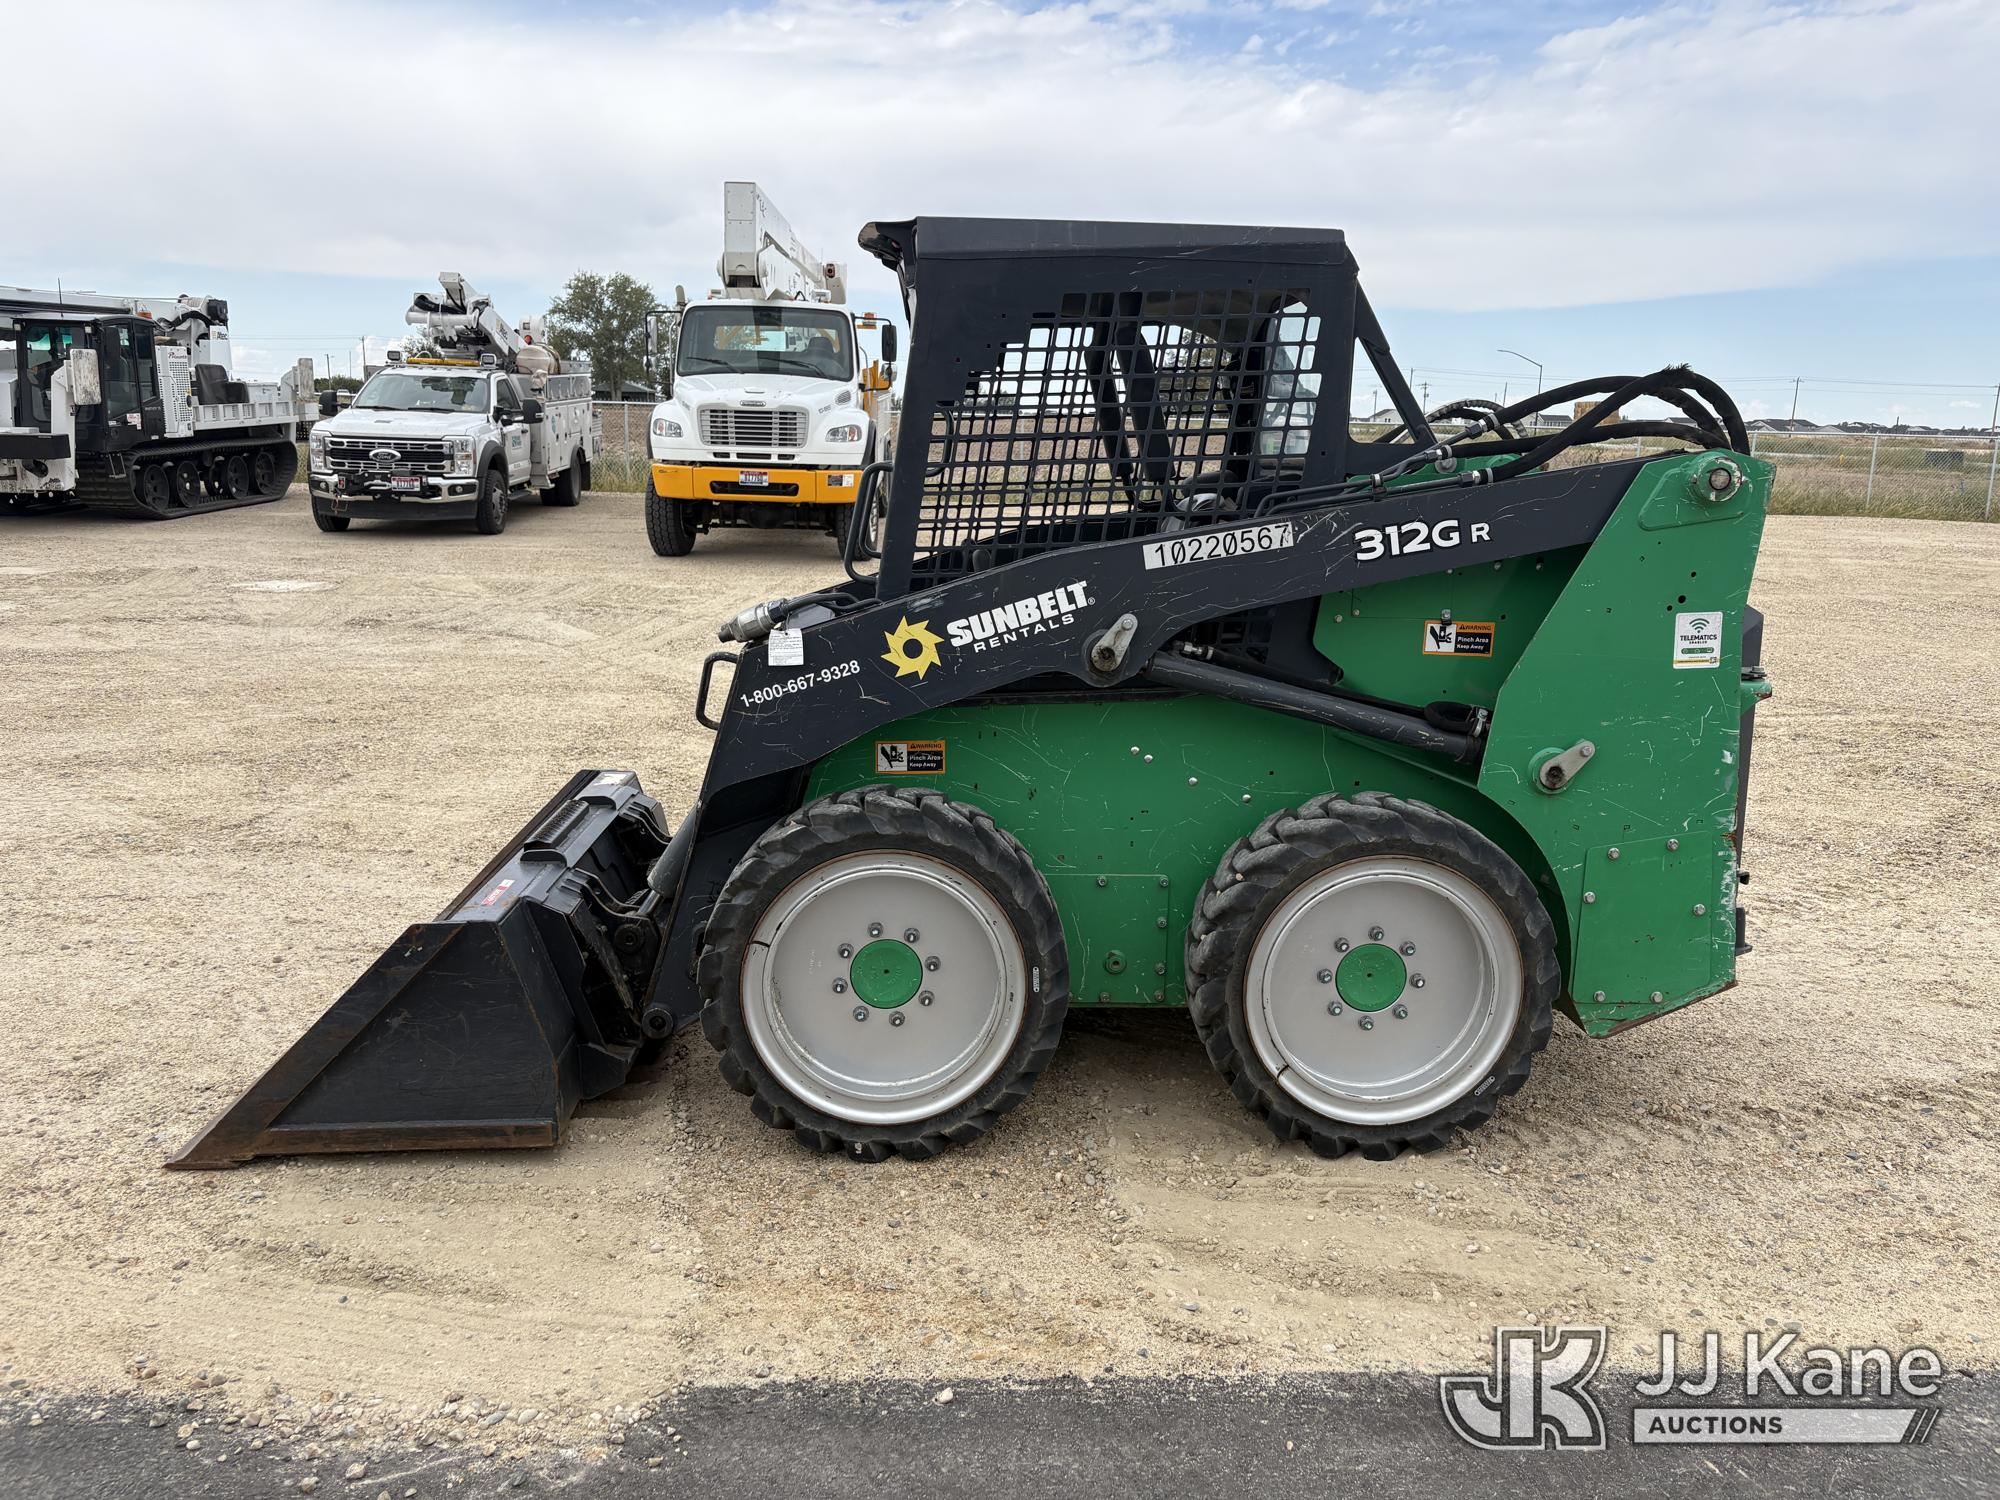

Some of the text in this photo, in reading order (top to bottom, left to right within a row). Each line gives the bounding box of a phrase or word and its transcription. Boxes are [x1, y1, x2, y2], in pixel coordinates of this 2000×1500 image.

[376, 452, 391, 460] Ford
[1155, 524, 1290, 567] 10220567
[1354, 519, 1491, 561] 312G R
[973, 613, 1075, 654] RENTALS
[740, 660, 861, 707] 1-800-667-9328
